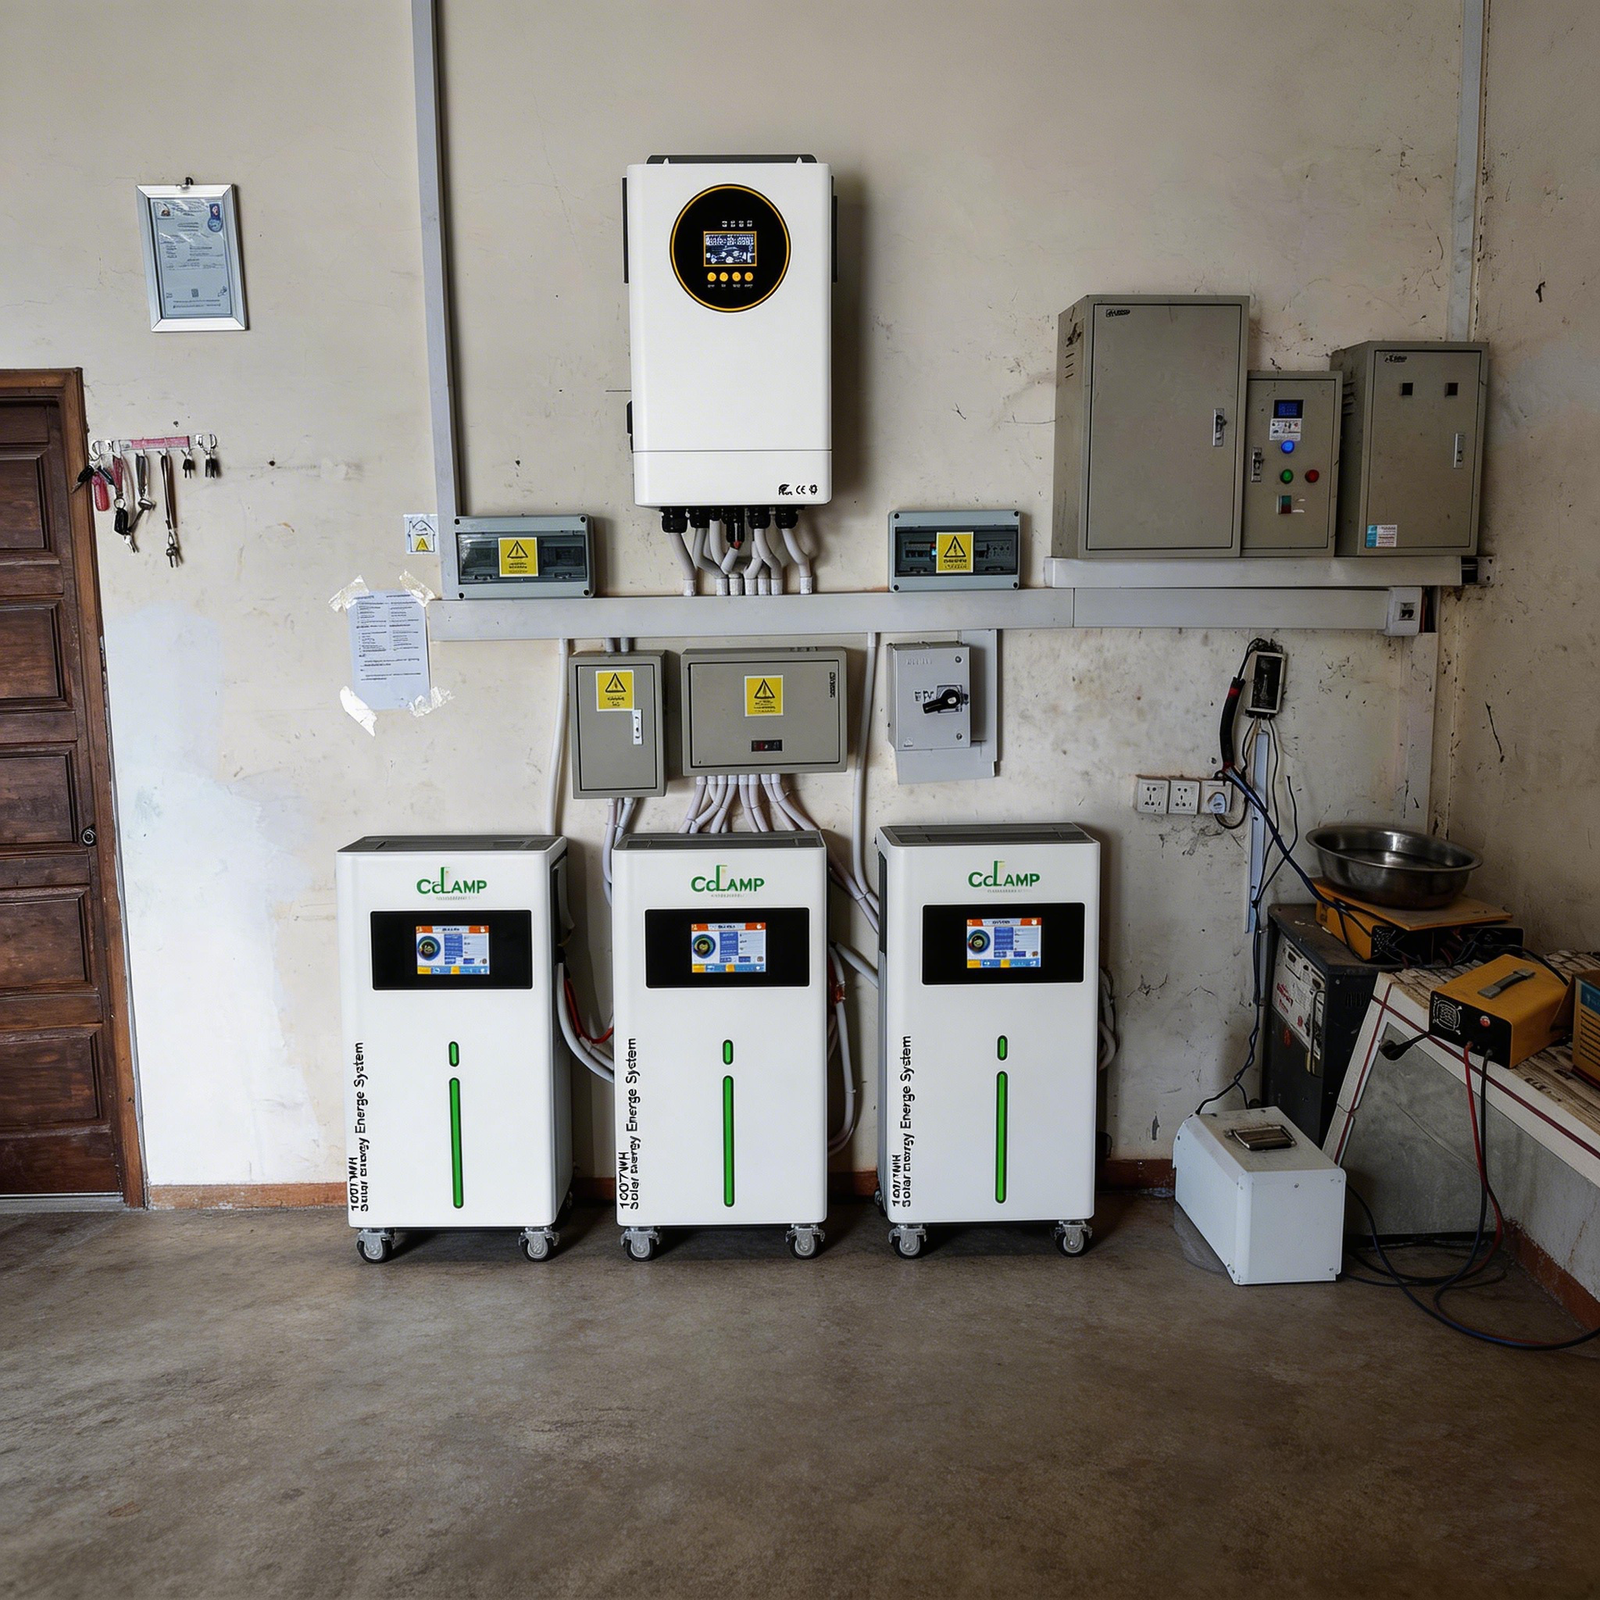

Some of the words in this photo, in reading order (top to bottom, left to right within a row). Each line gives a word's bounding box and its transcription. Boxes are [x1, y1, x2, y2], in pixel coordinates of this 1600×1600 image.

[900, 1036, 915, 1081] System
[355, 1091, 369, 1133] Energe
[626, 1088, 641, 1131] Energe
[900, 1085, 915, 1128] Energe
